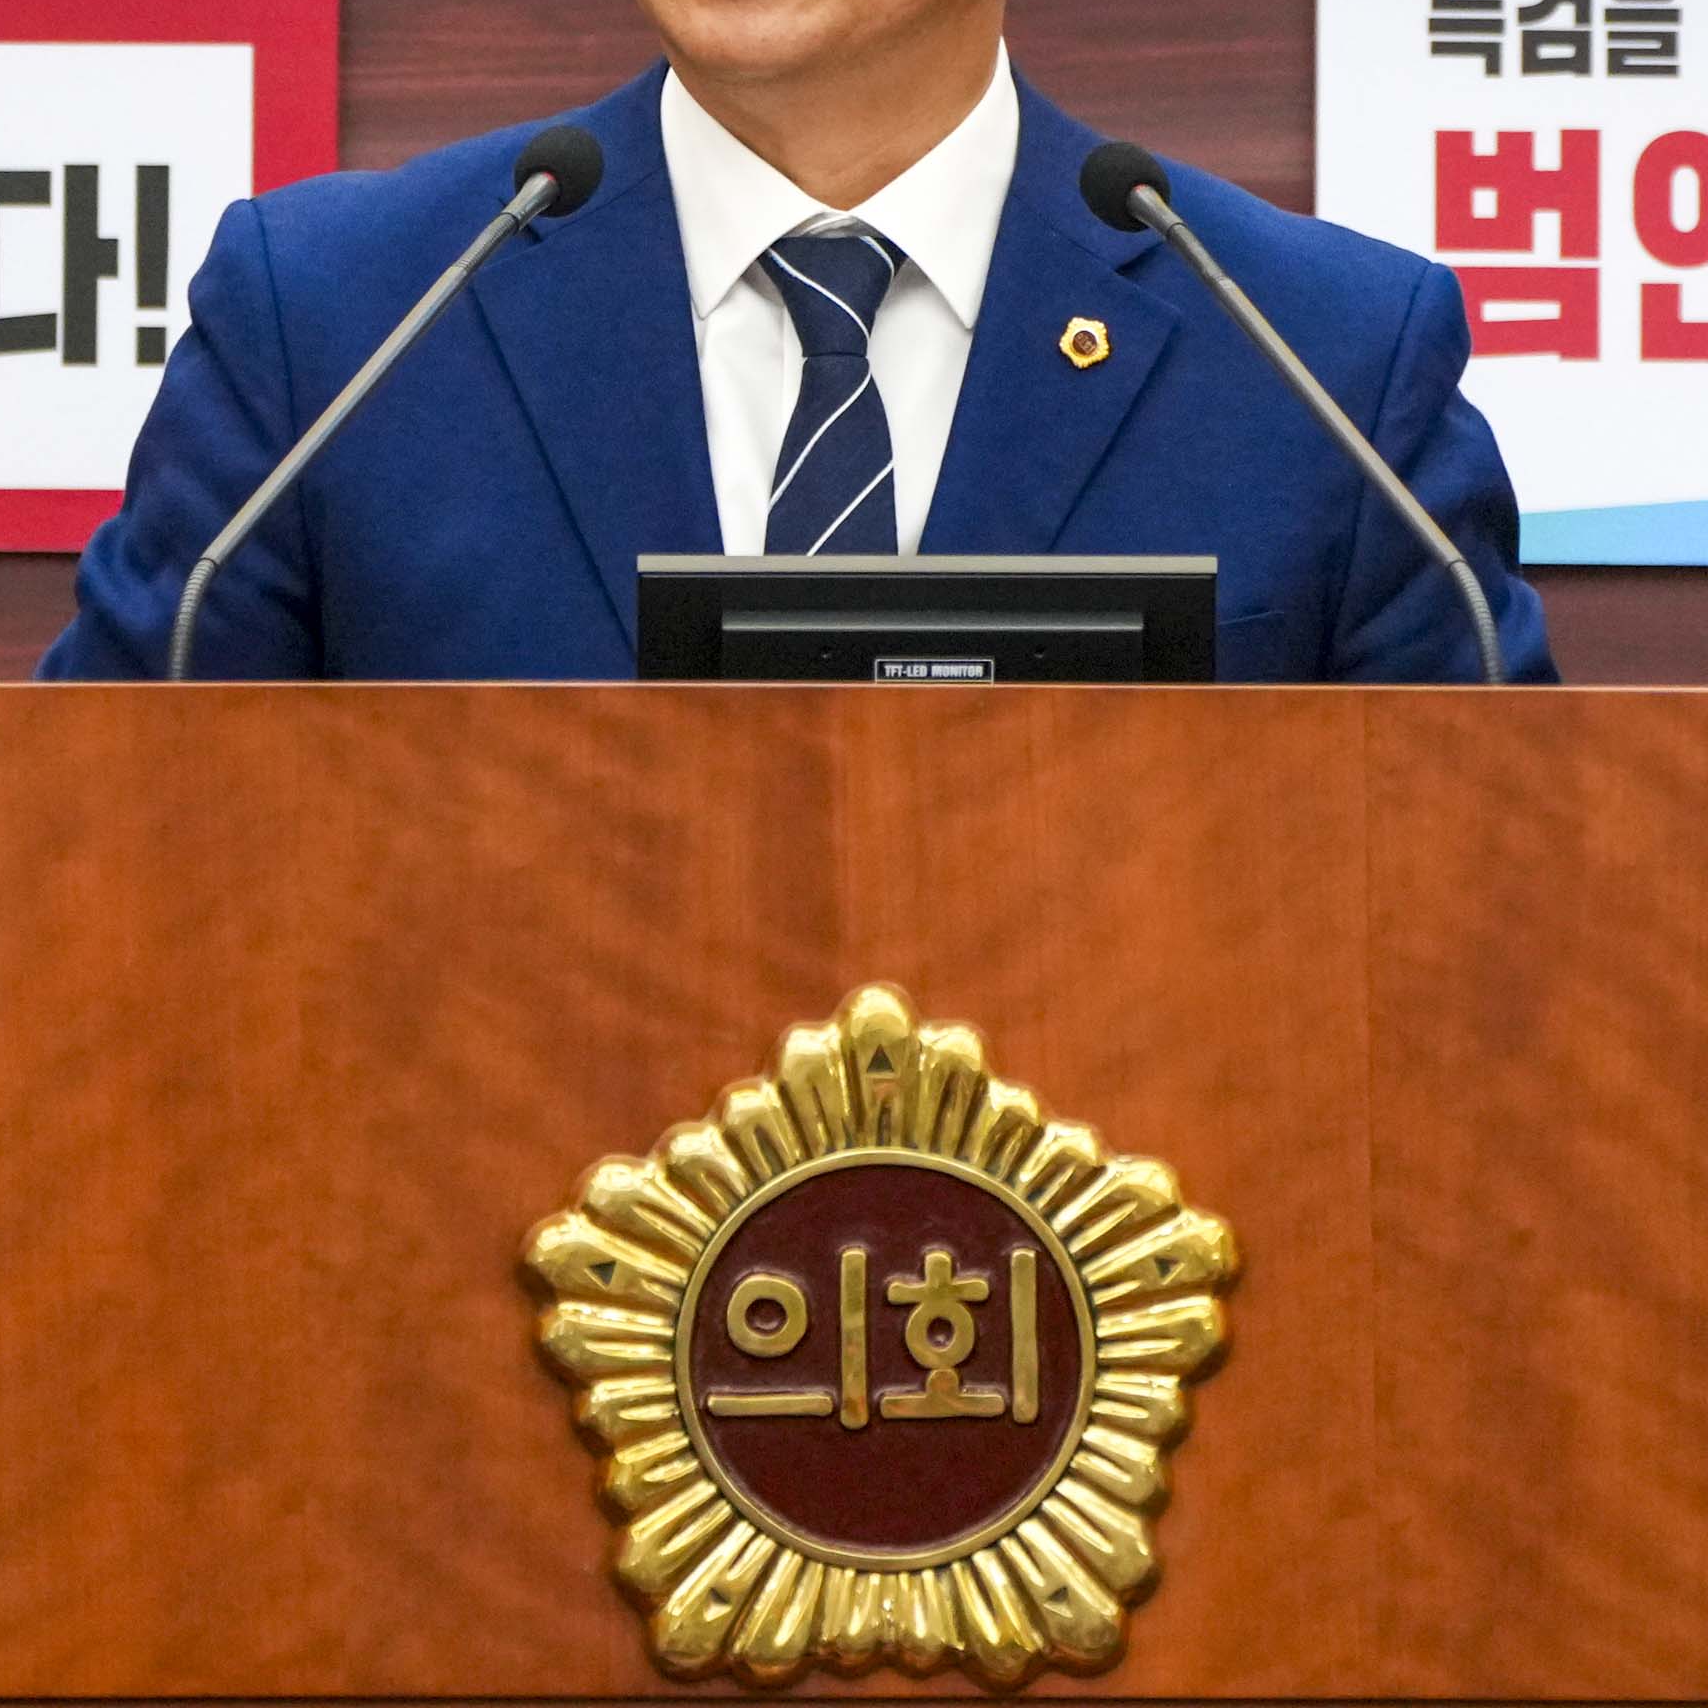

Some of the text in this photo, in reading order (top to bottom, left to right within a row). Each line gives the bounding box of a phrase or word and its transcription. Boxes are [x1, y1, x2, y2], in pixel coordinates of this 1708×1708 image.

[884, 664, 984, 678] TFT-LED MONITOR
[705, 1246, 1039, 1430] 의회
